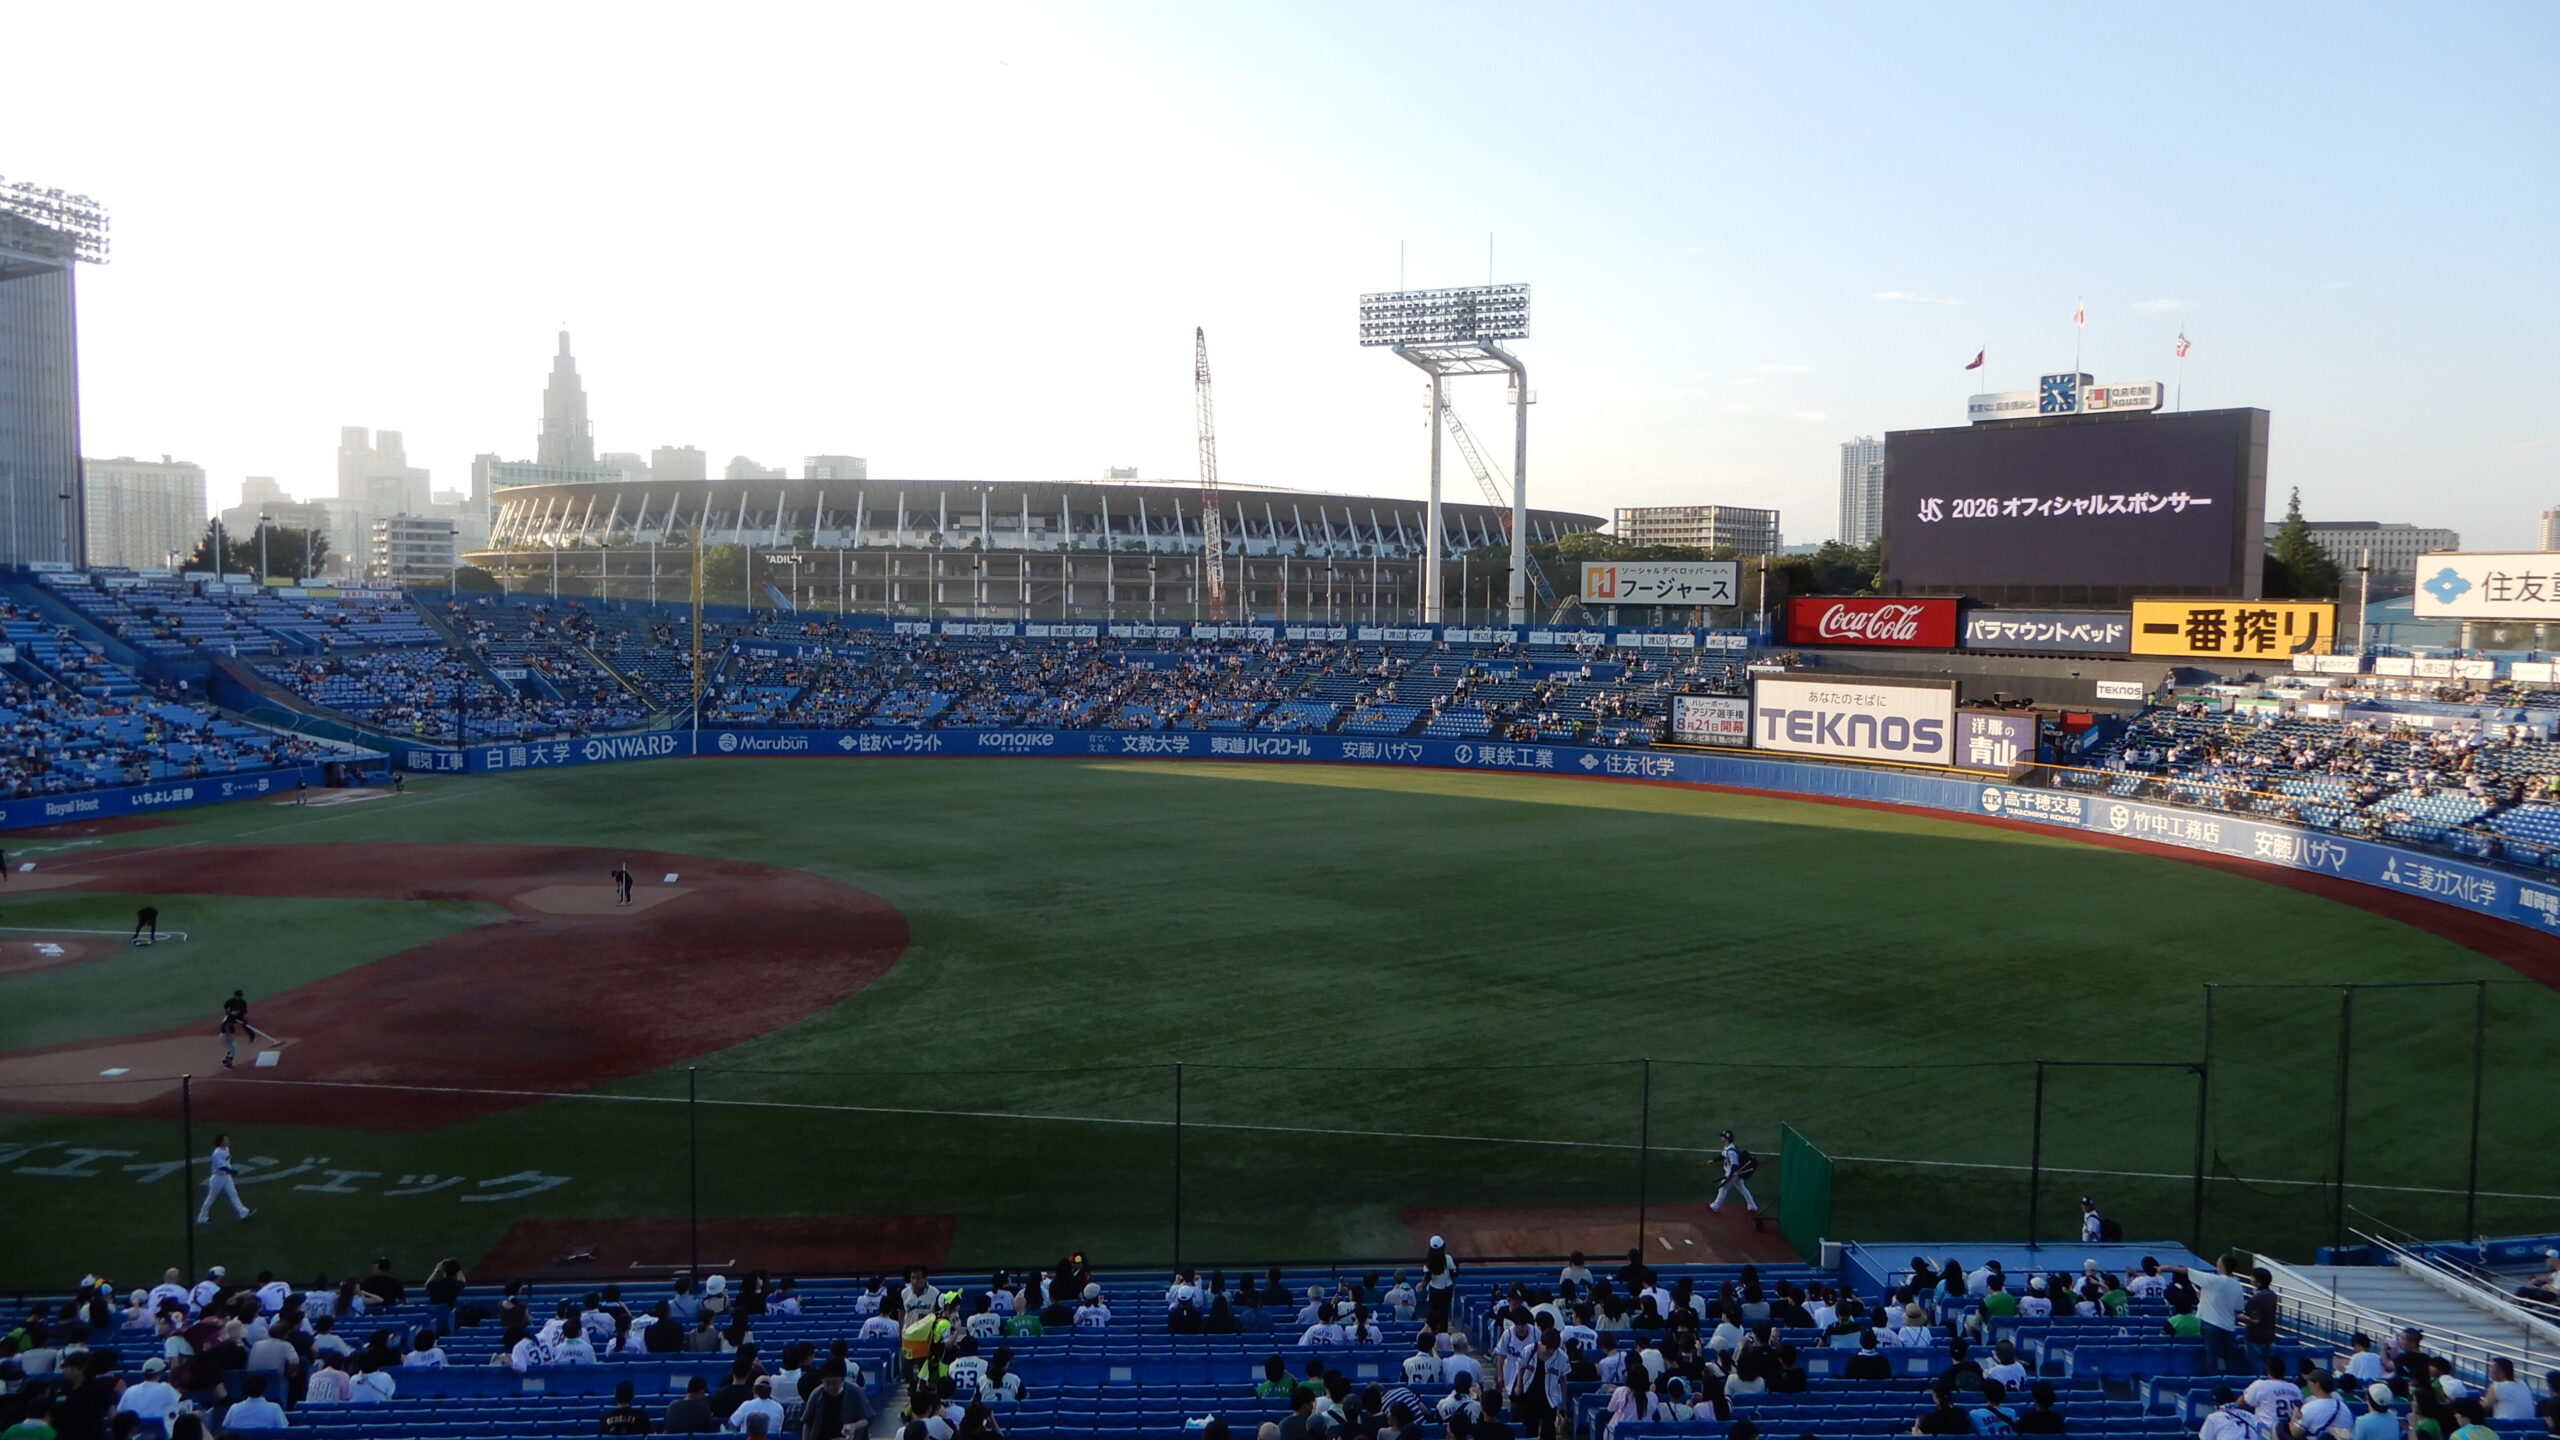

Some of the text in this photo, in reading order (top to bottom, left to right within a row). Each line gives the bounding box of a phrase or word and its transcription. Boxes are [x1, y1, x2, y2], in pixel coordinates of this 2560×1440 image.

[2112, 387, 2145, 397] OPEN
[1621, 577, 1729, 599] フージャース
[1819, 603, 1926, 641] Coca-Cola
[1965, 619, 2123, 644] パラマウントベッド
[2143, 609, 2321, 655] 一番搾り
[1808, 691, 1887, 707] あなたのそばに
[2098, 685, 2142, 696] TEKNOS
[1692, 700, 1731, 708] バレーボール
[1692, 708, 1745, 719] アジア選手権
[1759, 708, 1944, 754] TEKNOS
[1971, 717, 2015, 738] 洋服の
[582, 735, 678, 761] ONWARD
[741, 735, 808, 750] Marubun
[859, 733, 942, 752] 住友ベークライト
[1121, 734, 1190, 753] 文教大学
[1211, 737, 1311, 756] 東進ハイスクール
[1342, 741, 1423, 761] 安藤ハザマ
[1968, 737, 2016, 767] 青山
[1478, 745, 1554, 769] 東鉄工業
[1603, 753, 1675, 777] 住友化学
[46, 798, 100, 816] Royal Host
[132, 788, 194, 806] いちよし証券
[2004, 790, 2082, 816] 高千穂交易
[2005, 808, 2080, 824] TAKACHIHO KOHEKI
[2133, 809, 2220, 843] 竹中工務店
[2254, 831, 2347, 871] 安藤ハザマ
[2403, 861, 2496, 905] 三菱ガス化学
[2519, 887, 2560, 916] 加賀電
[955, 1371, 978, 1388] 63
